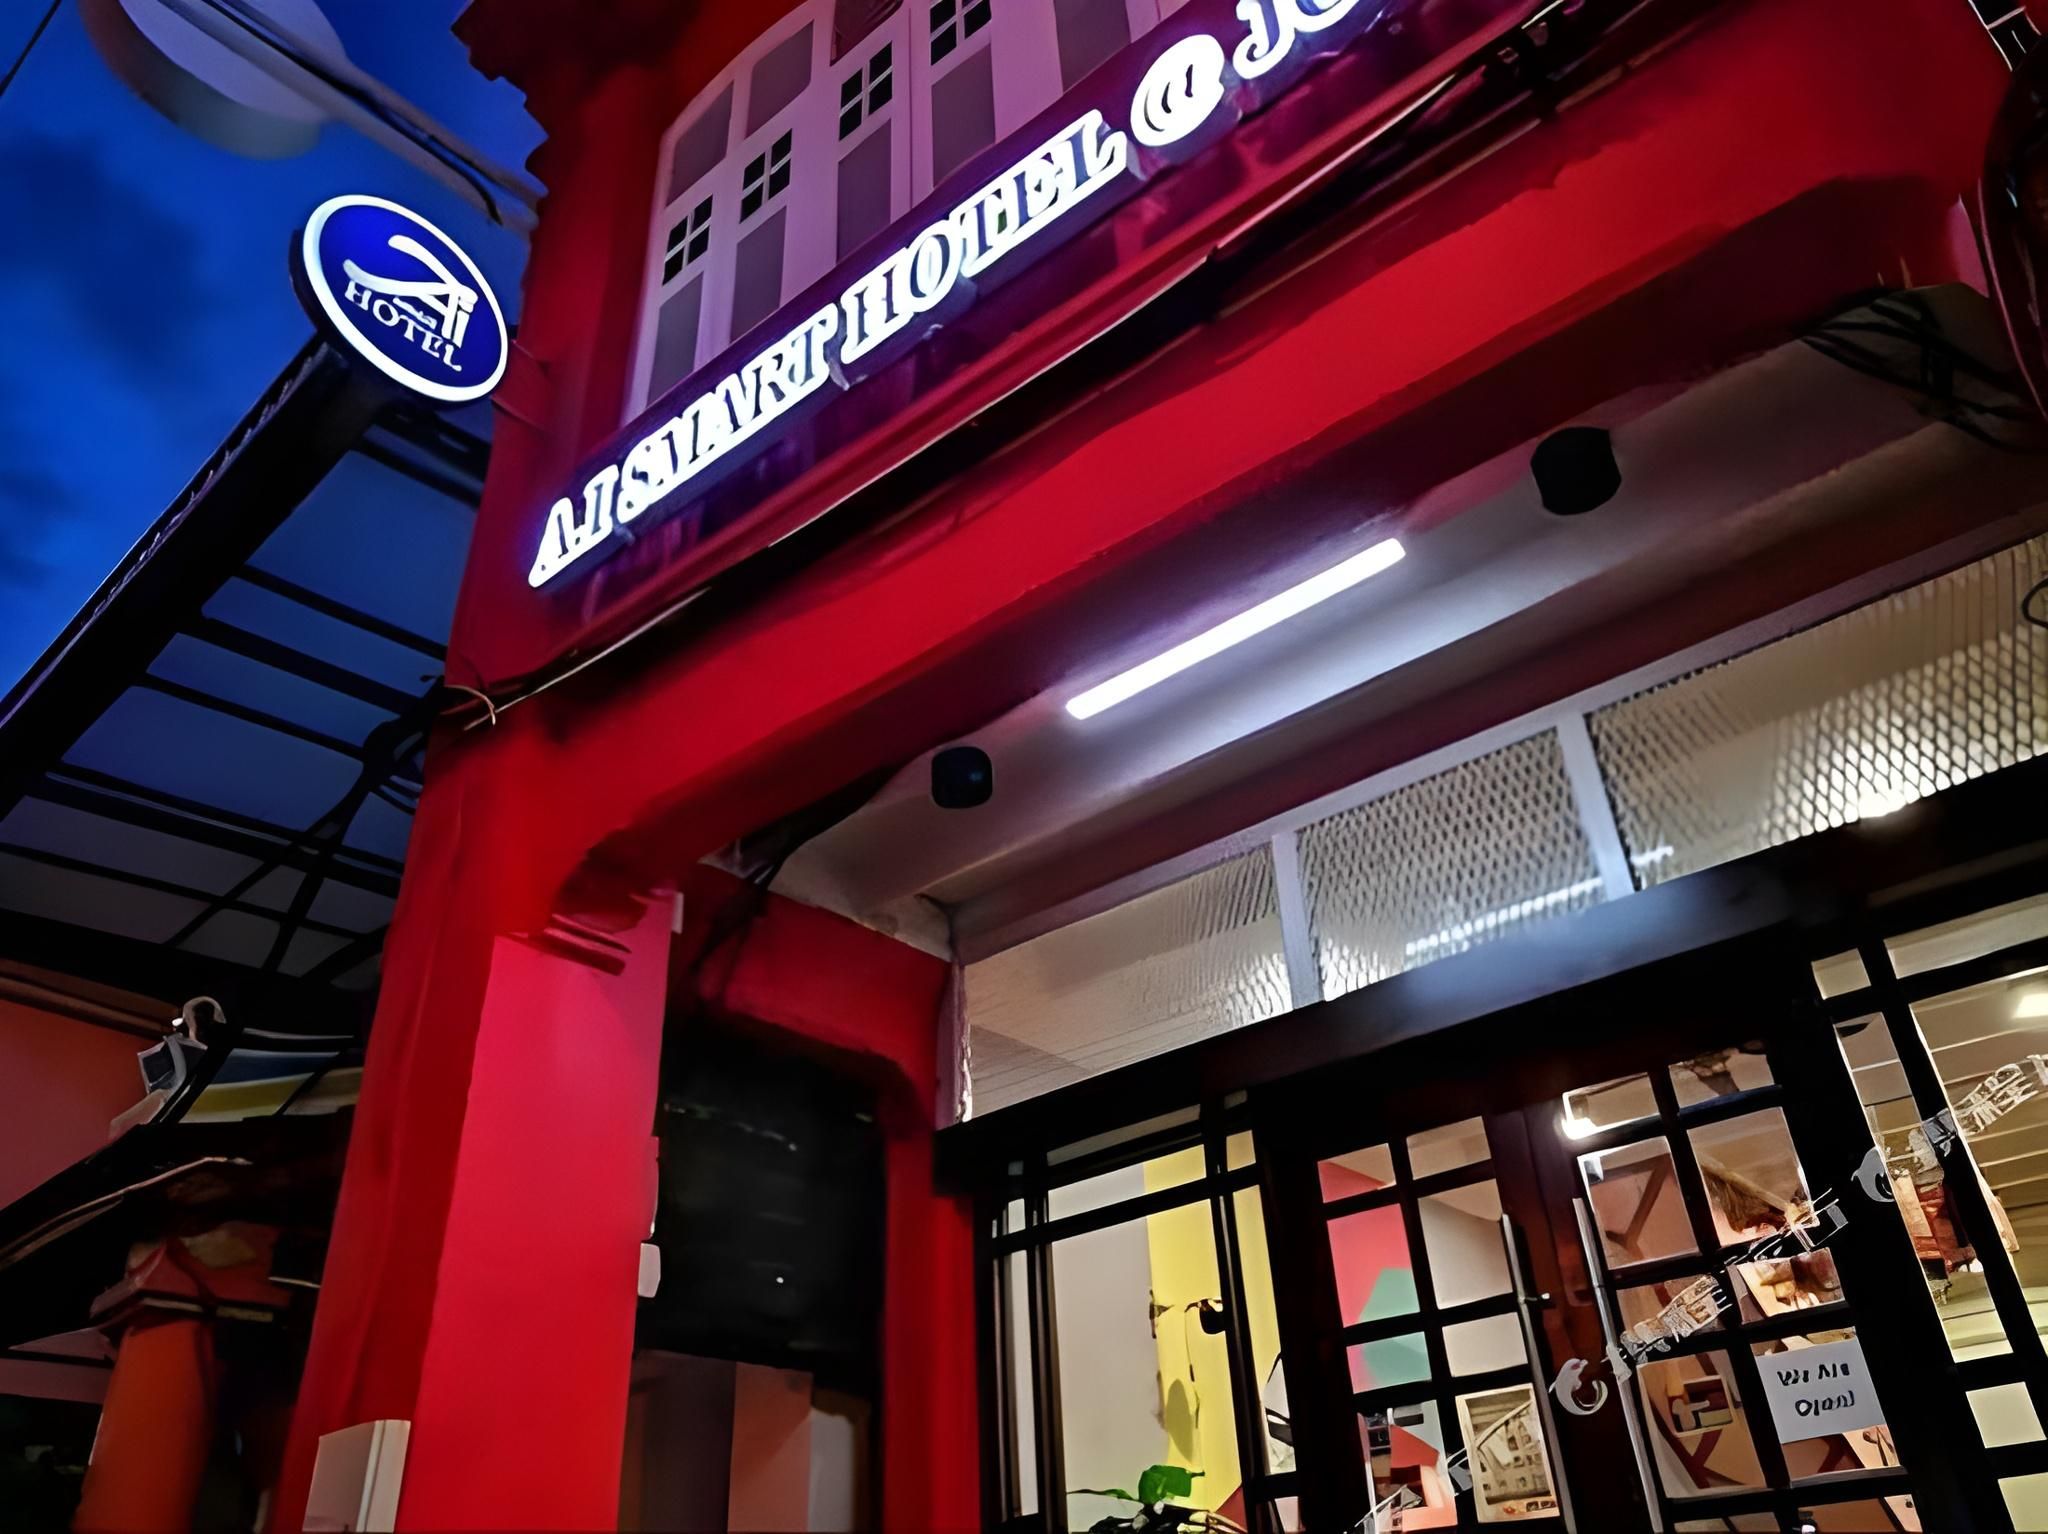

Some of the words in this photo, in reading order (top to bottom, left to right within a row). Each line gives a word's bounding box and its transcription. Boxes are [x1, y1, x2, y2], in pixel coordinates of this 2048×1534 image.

[344, 280, 462, 372] HOTEL
[617, 302, 839, 523] SMART
[840, 109, 1127, 365] HOTEL
